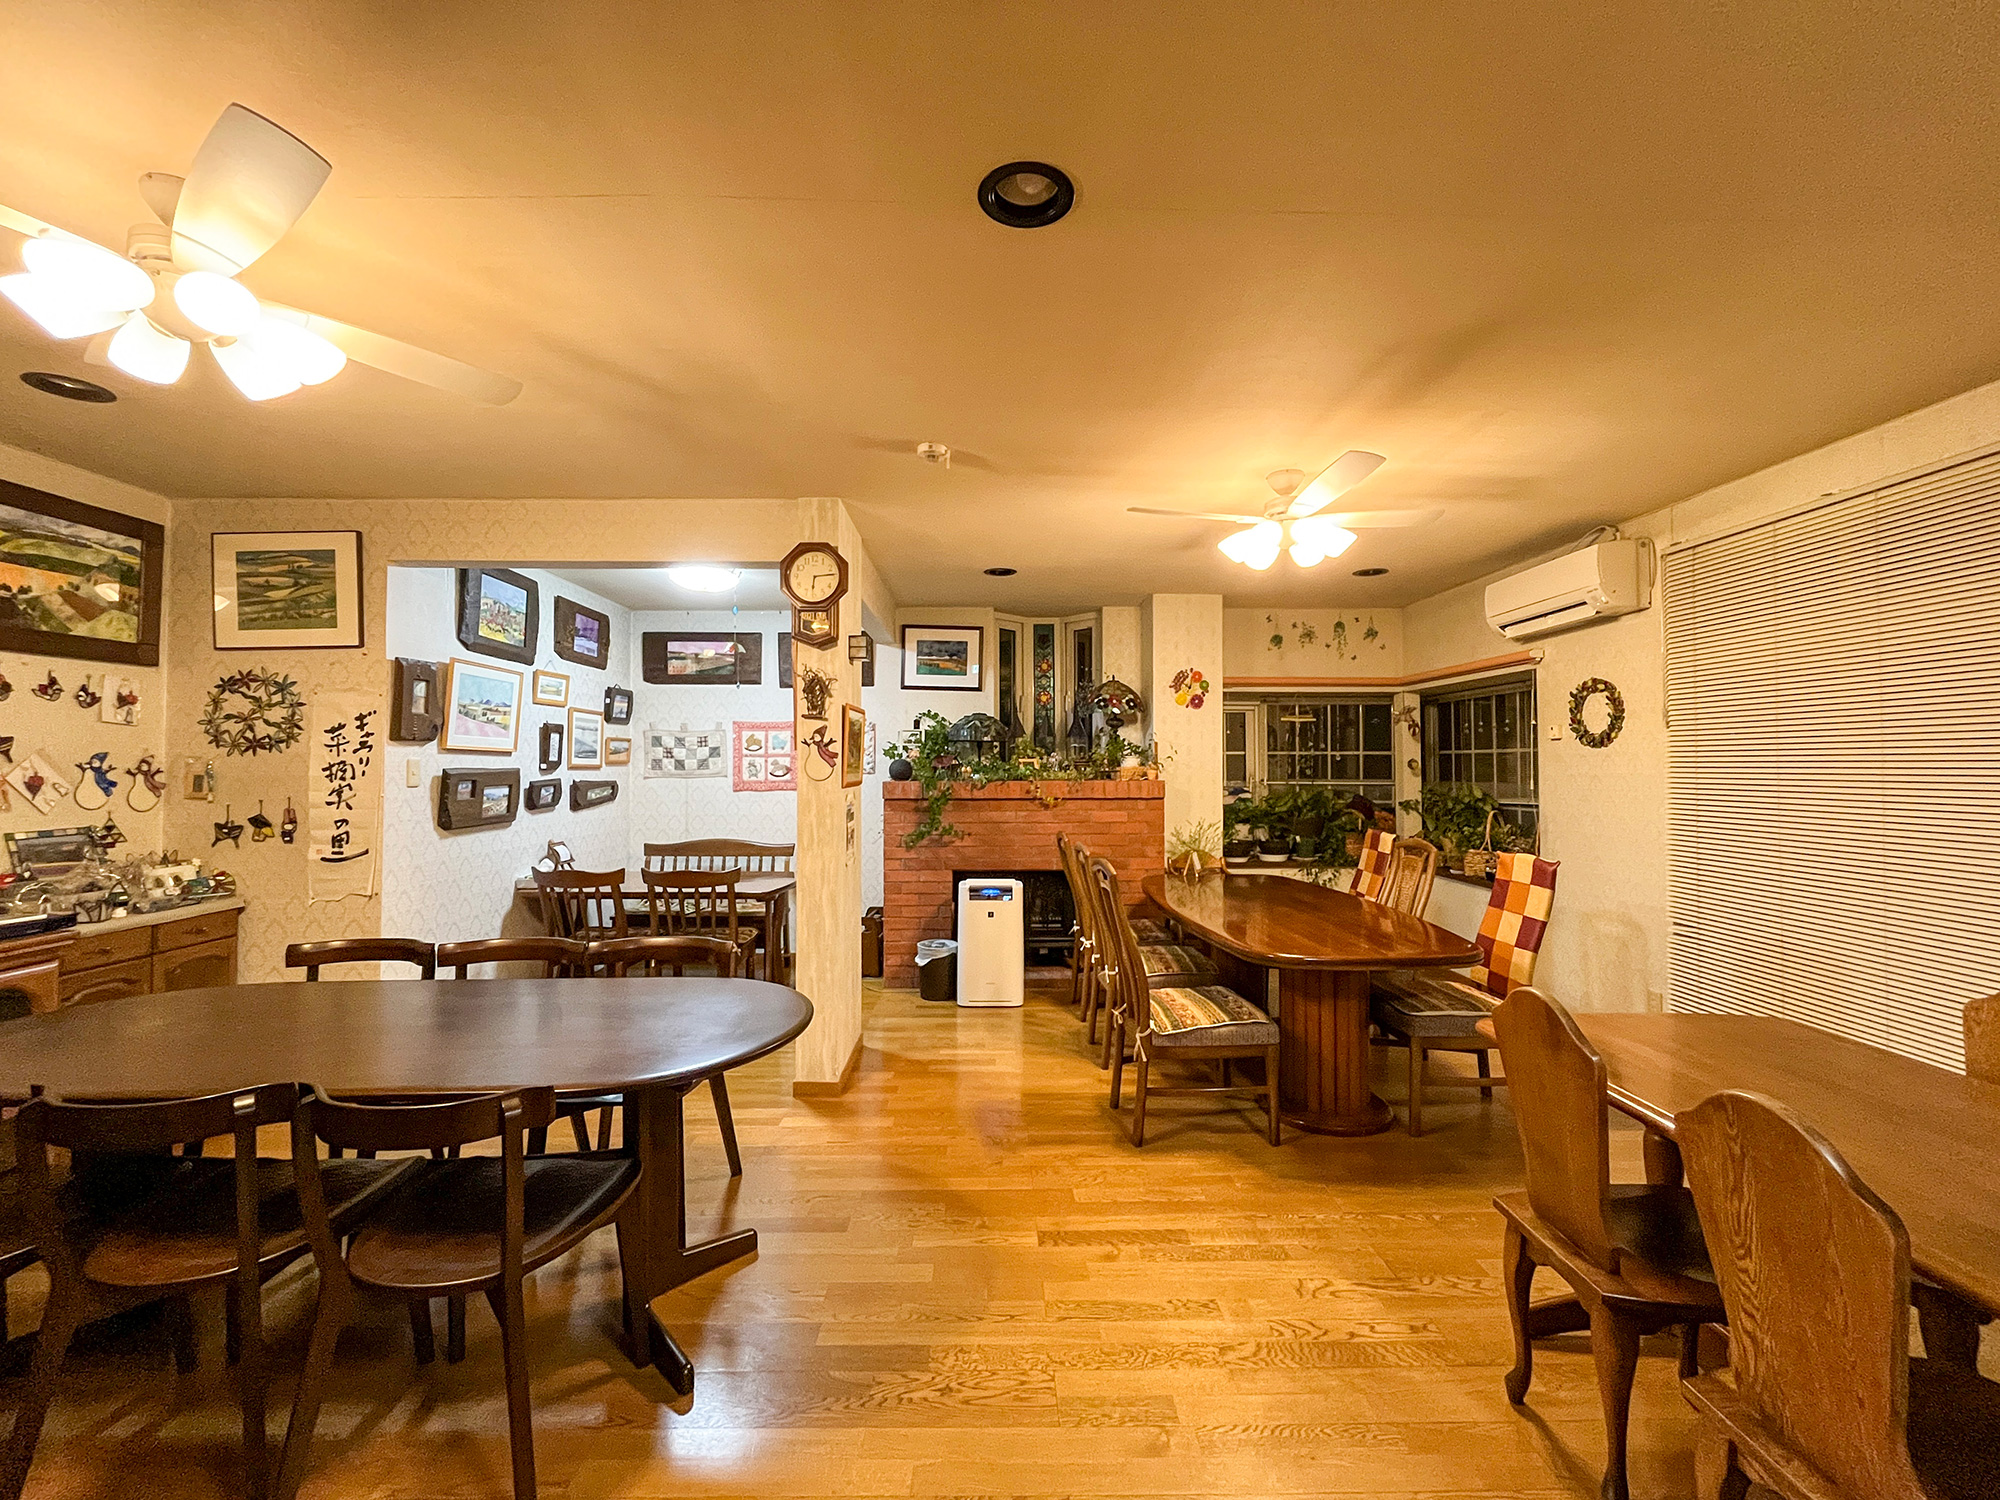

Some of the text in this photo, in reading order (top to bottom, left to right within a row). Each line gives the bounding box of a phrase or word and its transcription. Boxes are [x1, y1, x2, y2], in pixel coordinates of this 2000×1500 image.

[804, 557, 810, 565] 11
[811, 554, 819, 563] 12
[796, 563, 805, 571] 10
[828, 564, 833, 572] 2
[793, 572, 799, 580] 9
[804, 588, 809, 596] 7
